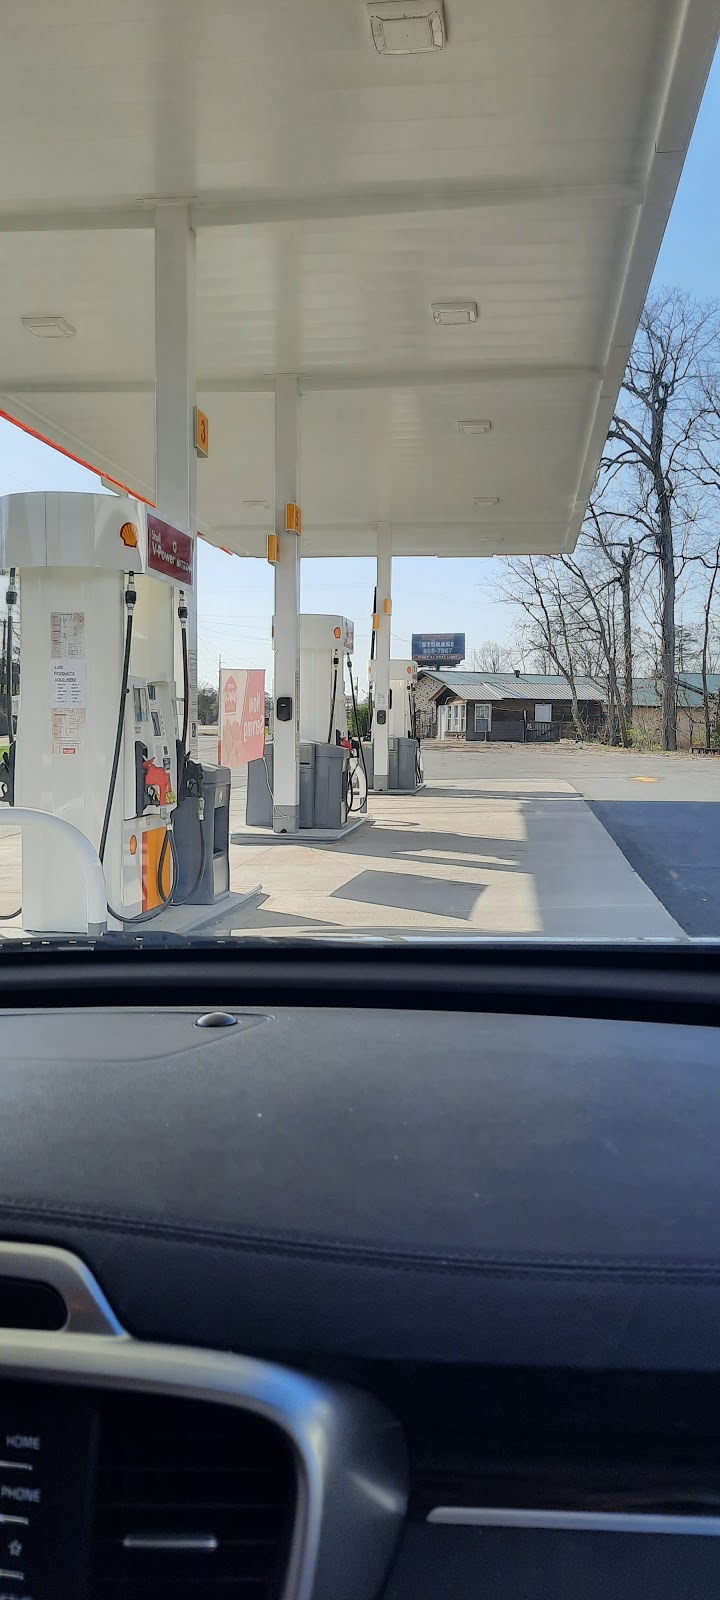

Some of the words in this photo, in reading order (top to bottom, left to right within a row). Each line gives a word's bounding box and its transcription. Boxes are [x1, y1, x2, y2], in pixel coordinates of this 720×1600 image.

[200, 419, 207, 443] 3
[151, 529, 162, 543] Shell
[151, 541, 176, 565] V-Power
[6, 1434, 41, 1450] HOME
[0, 1485, 41, 1503] PHONE
